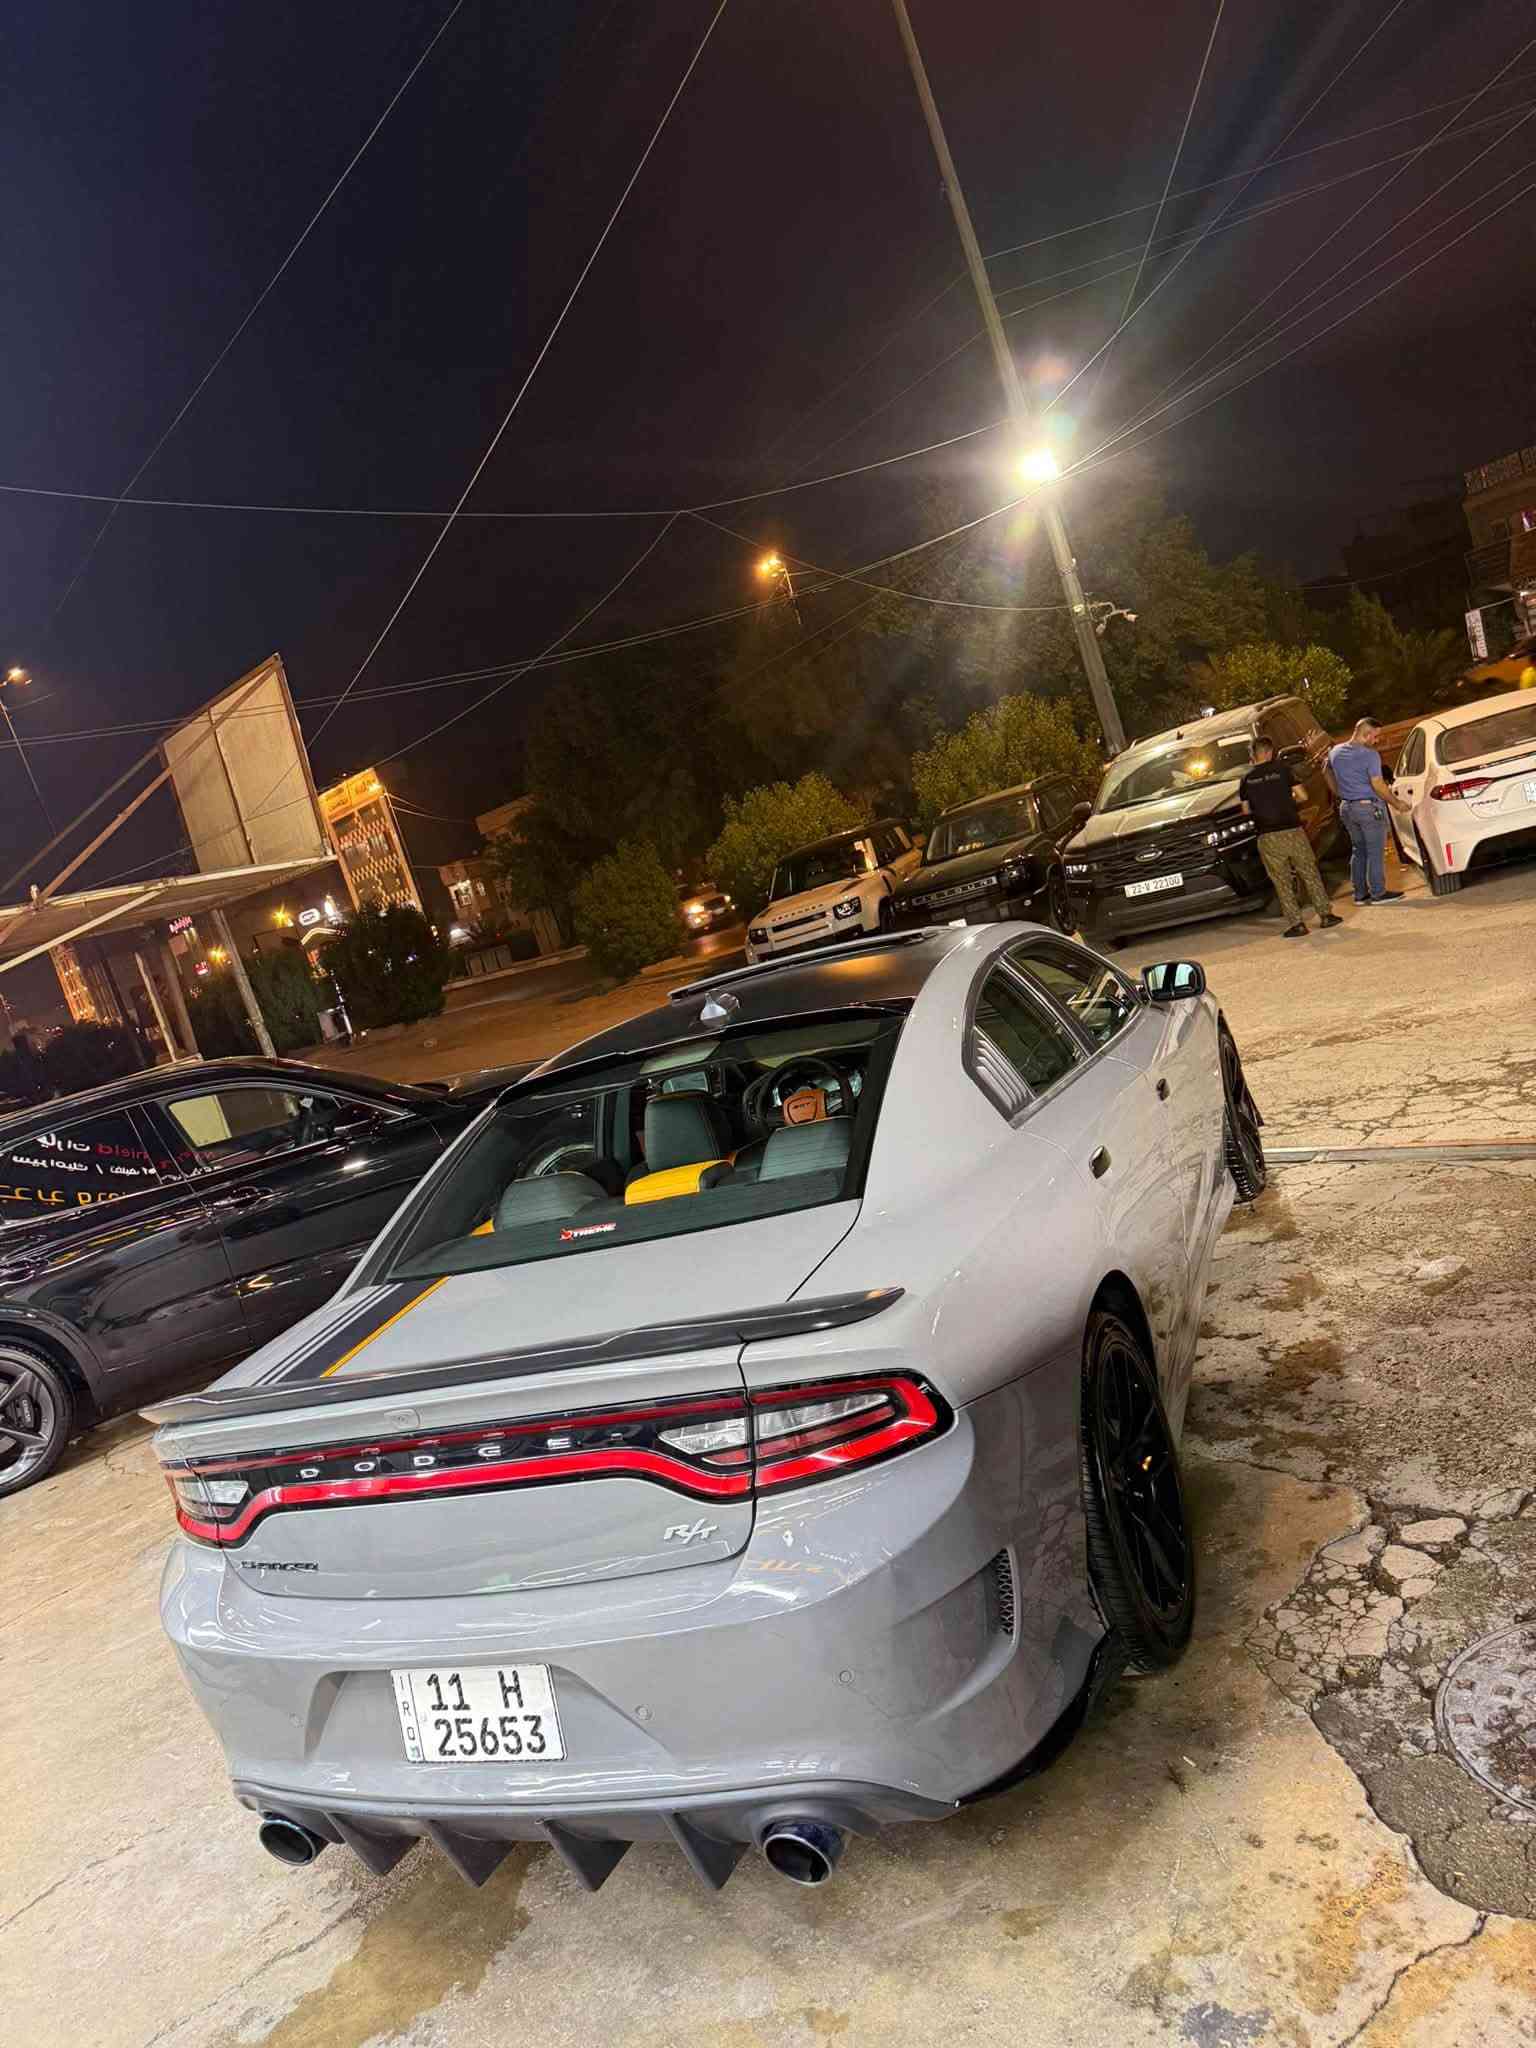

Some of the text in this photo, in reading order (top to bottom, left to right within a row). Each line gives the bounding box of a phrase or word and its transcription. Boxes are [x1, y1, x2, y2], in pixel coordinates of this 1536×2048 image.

[300, 1437, 571, 1480] DODGE
[663, 1519, 718, 1544] R/T
[427, 1669, 524, 1711] 11 H
[434, 1714, 546, 1757] 25653
